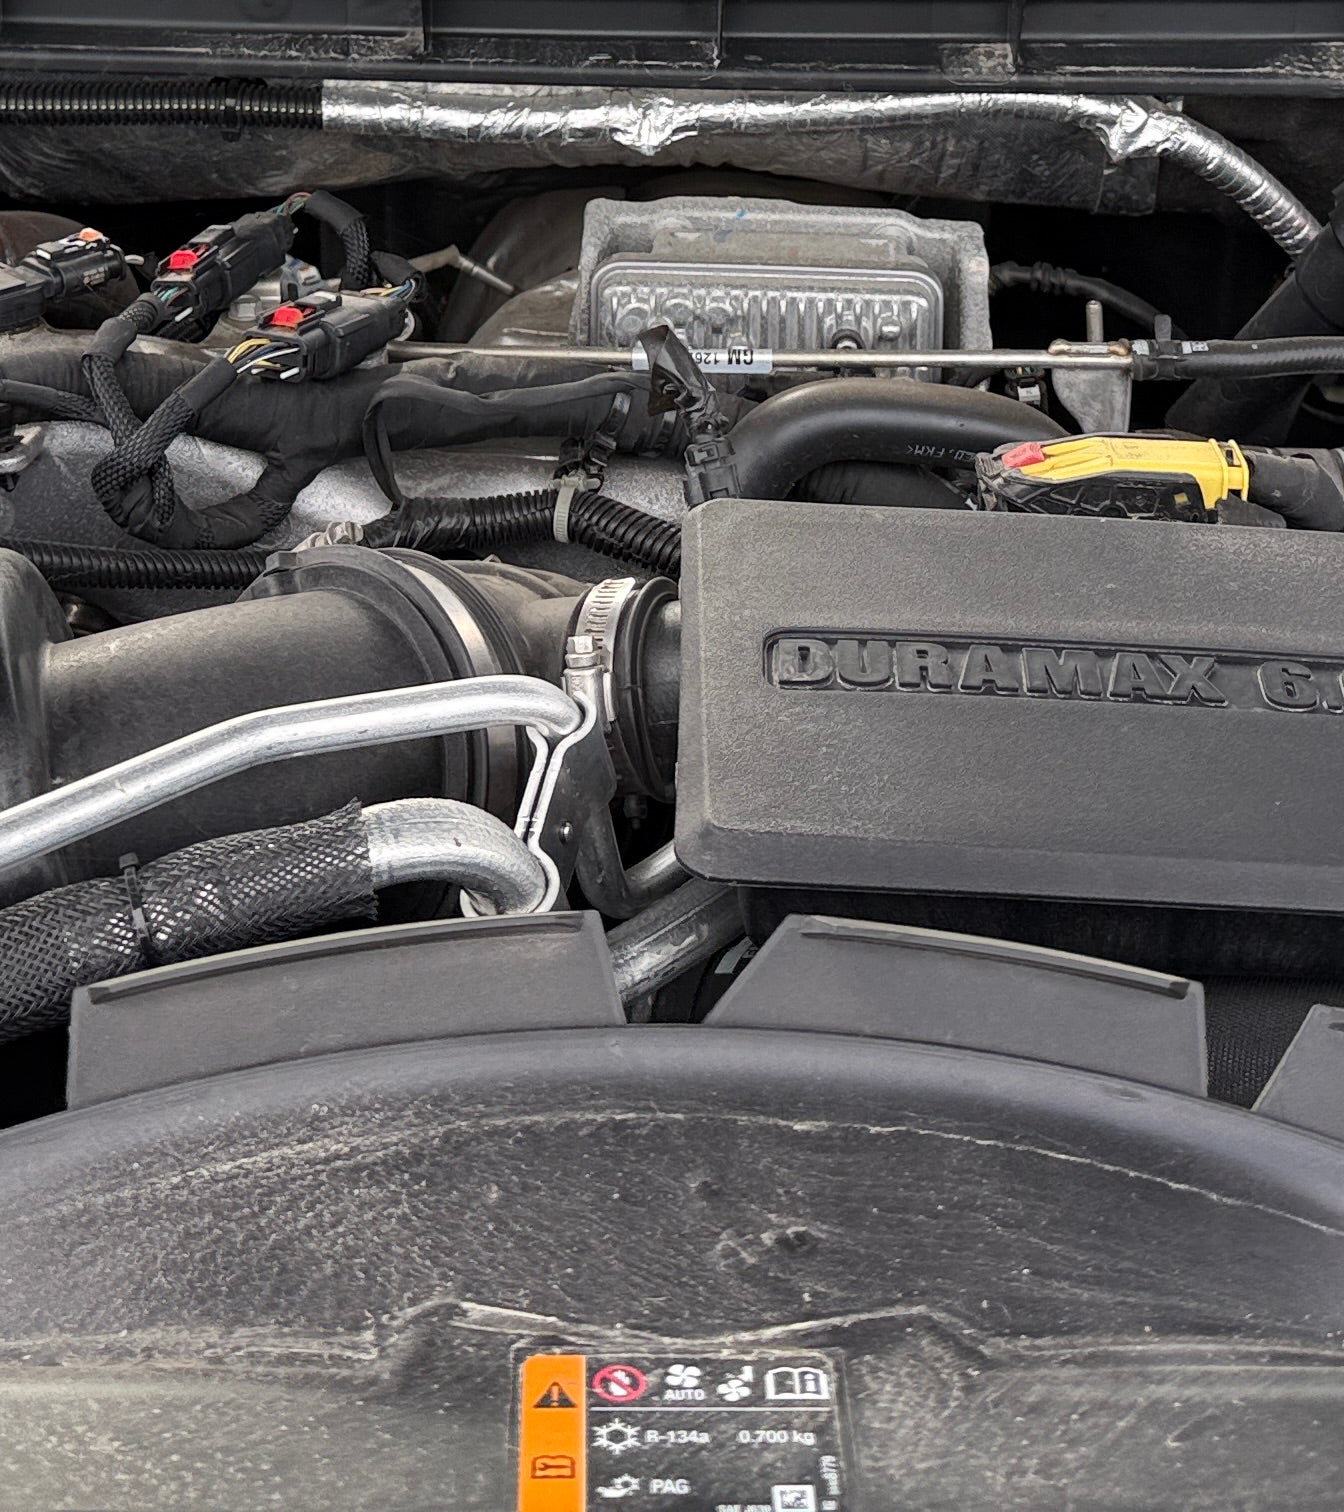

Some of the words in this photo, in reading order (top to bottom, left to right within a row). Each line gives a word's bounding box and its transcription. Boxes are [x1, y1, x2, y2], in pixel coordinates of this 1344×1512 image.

[727, 349, 754, 365] GM
[772, 638, 1229, 708] DURAMAX
[664, 1389, 705, 1400] AUTO
[645, 1430, 711, 1444] R-134a
[738, 1430, 789, 1444] 0.700
[793, 1430, 816, 1447] kg
[649, 1479, 690, 1494] PAG
